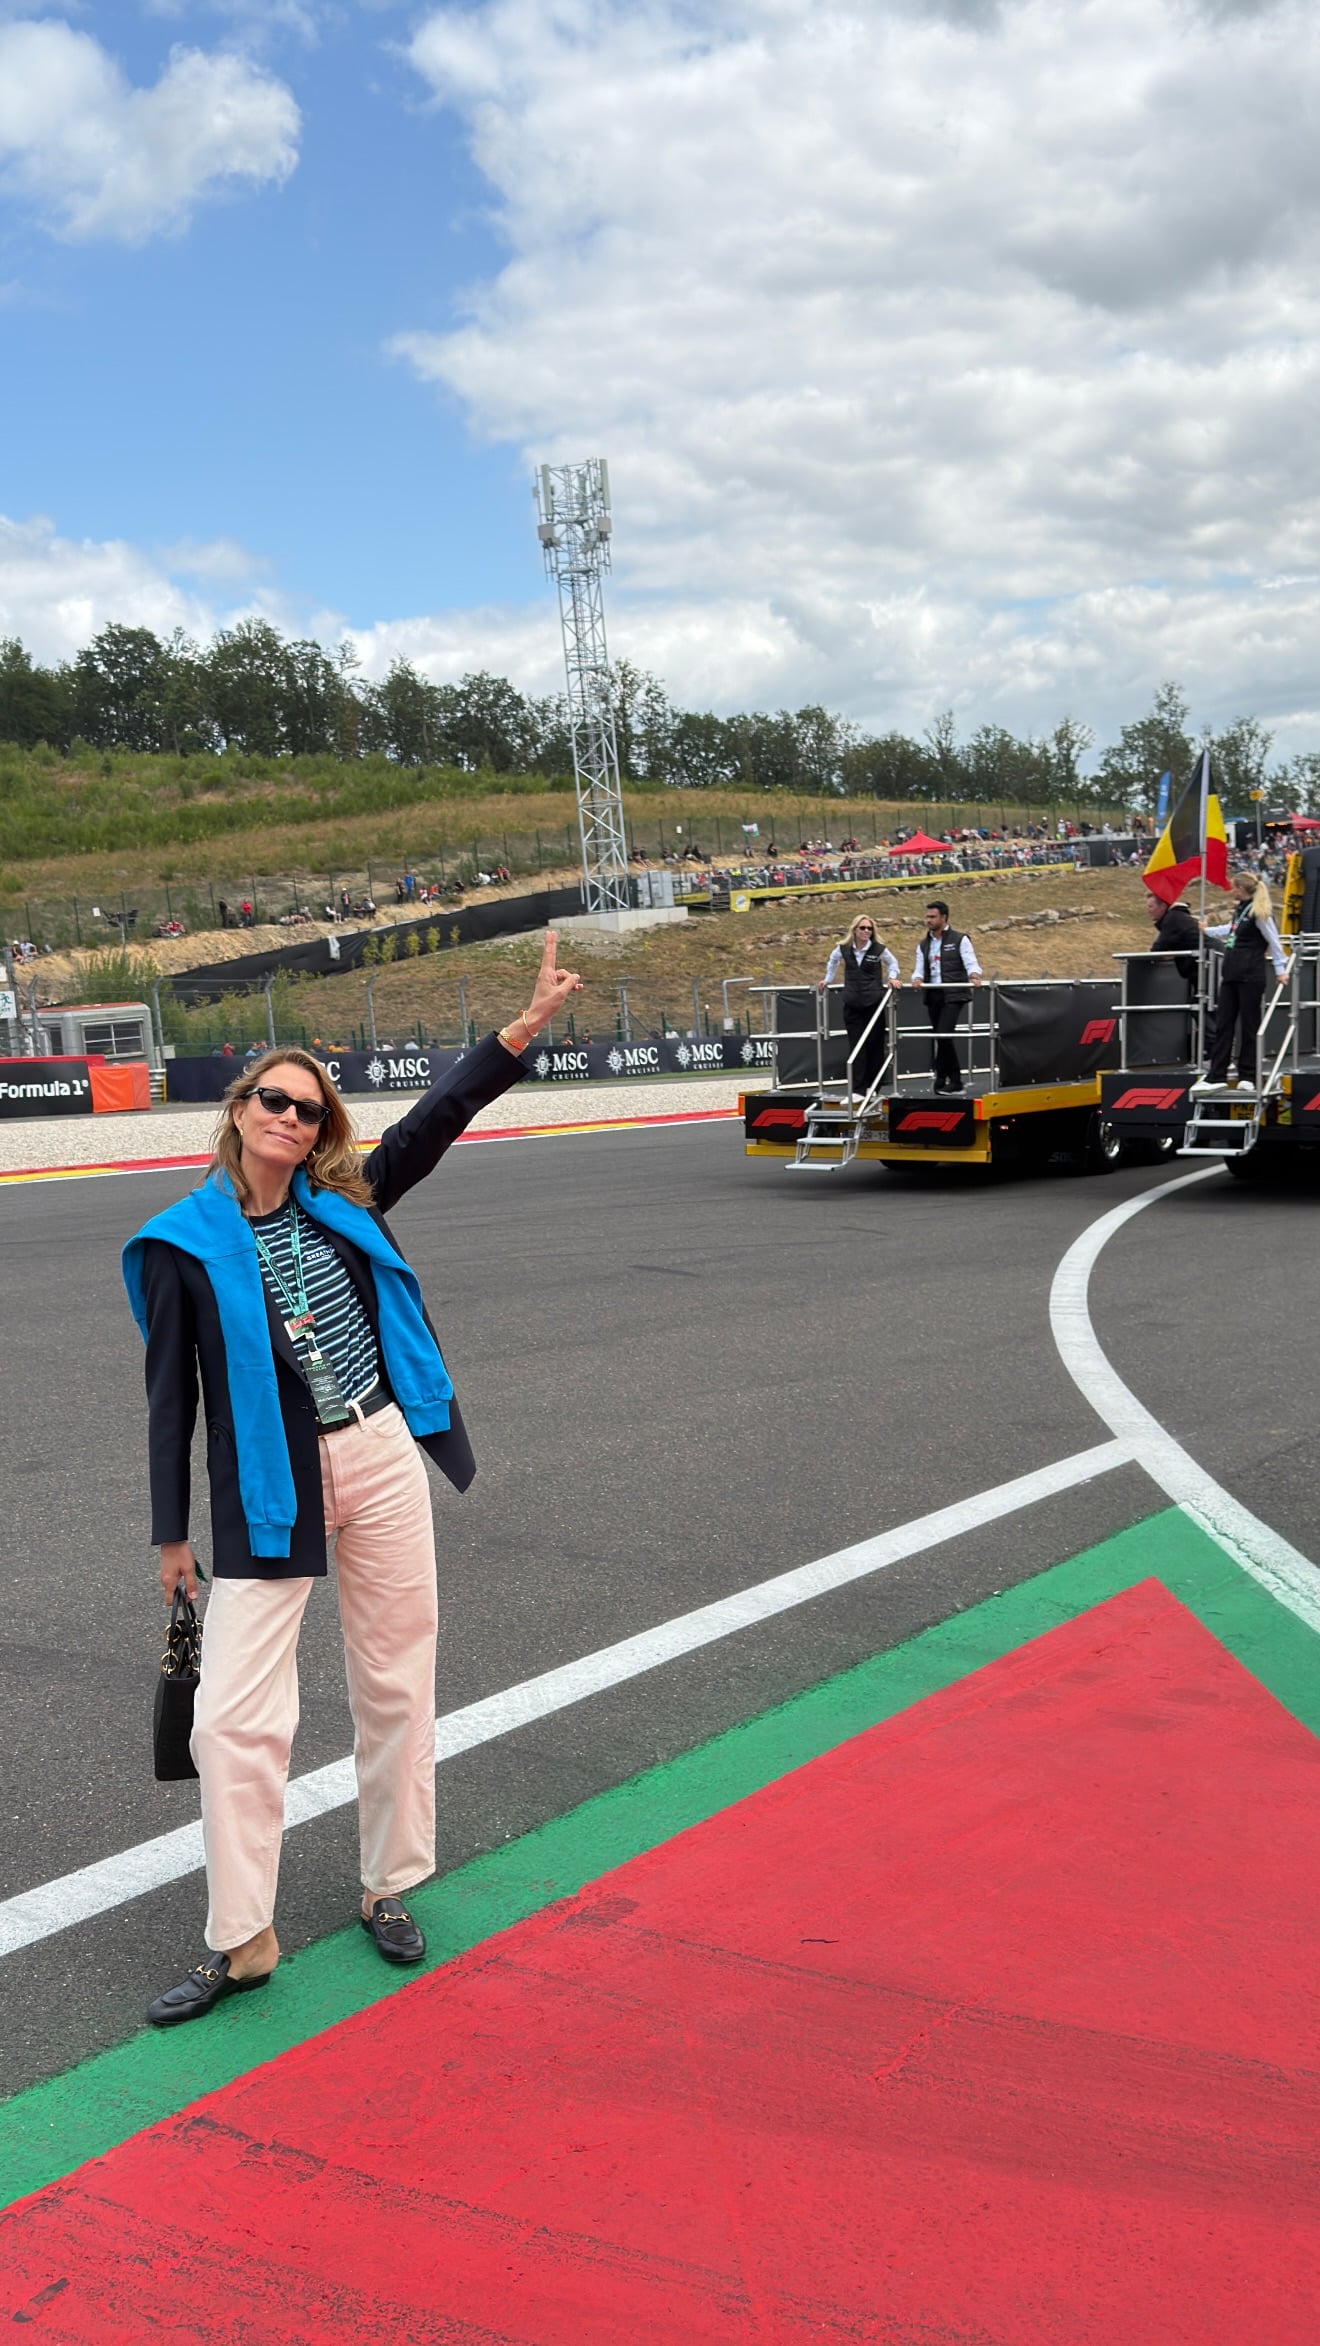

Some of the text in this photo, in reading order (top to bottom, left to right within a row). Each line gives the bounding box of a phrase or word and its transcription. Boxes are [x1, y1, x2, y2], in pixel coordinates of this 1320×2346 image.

[552, 1051, 589, 1072] MSC
[623, 1046, 659, 1067] MSC
[691, 1043, 724, 1062] MSC
[388, 1057, 431, 1079] MSC
[626, 1066, 661, 1075] CRUISES
[692, 1062, 724, 1070] CRUISES
[389, 1079, 432, 1088] CRUISES
[552, 1072, 590, 1081] CRUISES
[0, 1081, 71, 1099] Formula
